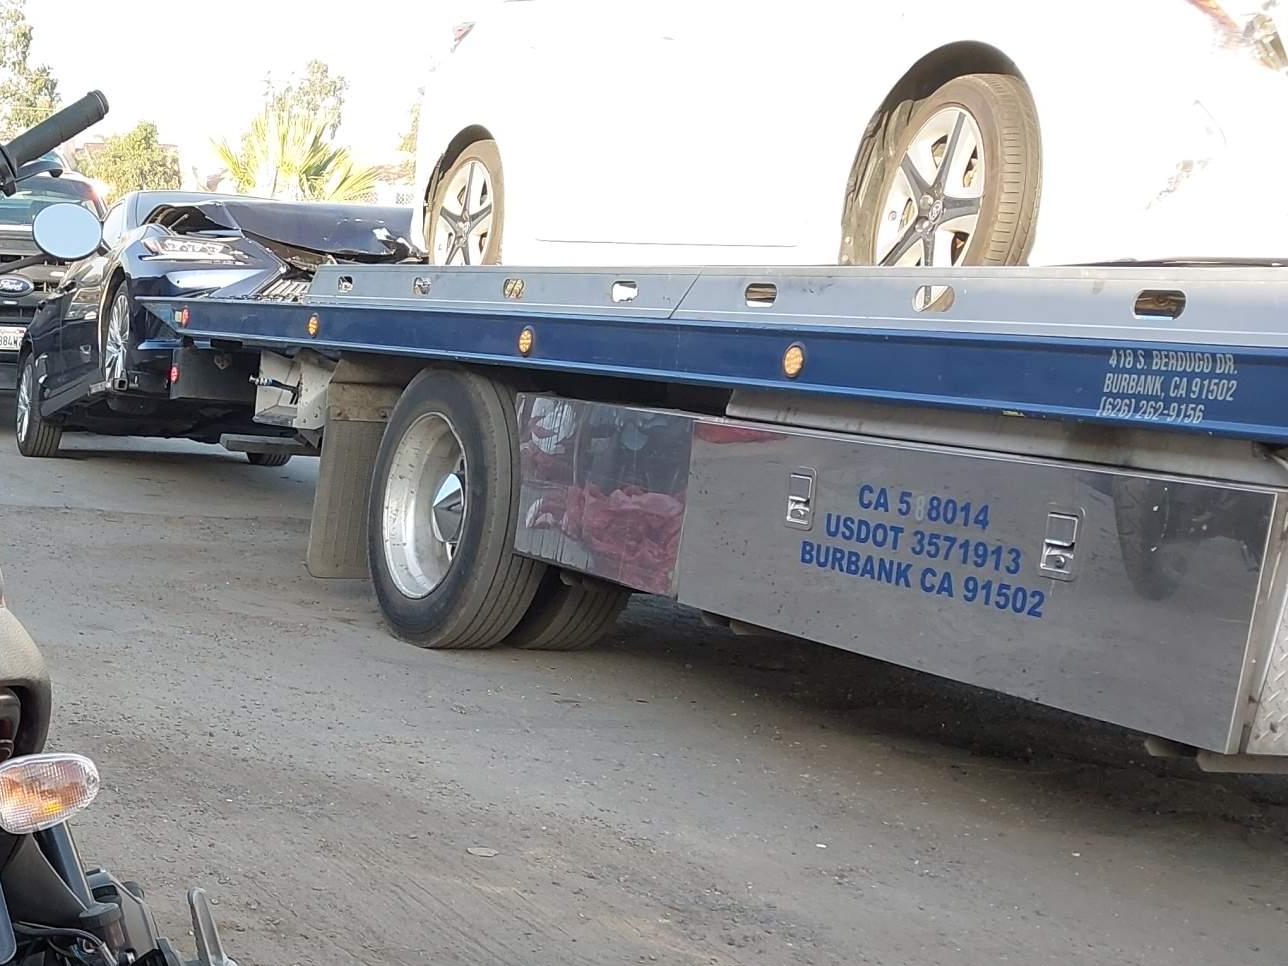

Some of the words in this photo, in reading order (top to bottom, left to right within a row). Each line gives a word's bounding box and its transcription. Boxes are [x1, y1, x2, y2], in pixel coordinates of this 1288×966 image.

[1108, 348, 1134, 369] 418
[1136, 350, 1148, 370] S.
[1151, 350, 1212, 374] BERDUGO
[1215, 353, 1238, 375] DR.
[1103, 373, 1165, 400] BURBANK,
[1169, 377, 1188, 398] CA
[1190, 377, 1238, 401] 91502
[1096, 396, 1136, 420] (626)
[1135, 400, 1205, 424] 262-9156
[858, 484, 890, 514] CA
[825, 512, 905, 551] USDOT
[910, 529, 1023, 576] 3571913
[800, 540, 913, 589] BURBANK
[919, 567, 955, 599] CA
[962, 575, 1046, 618] 91502
